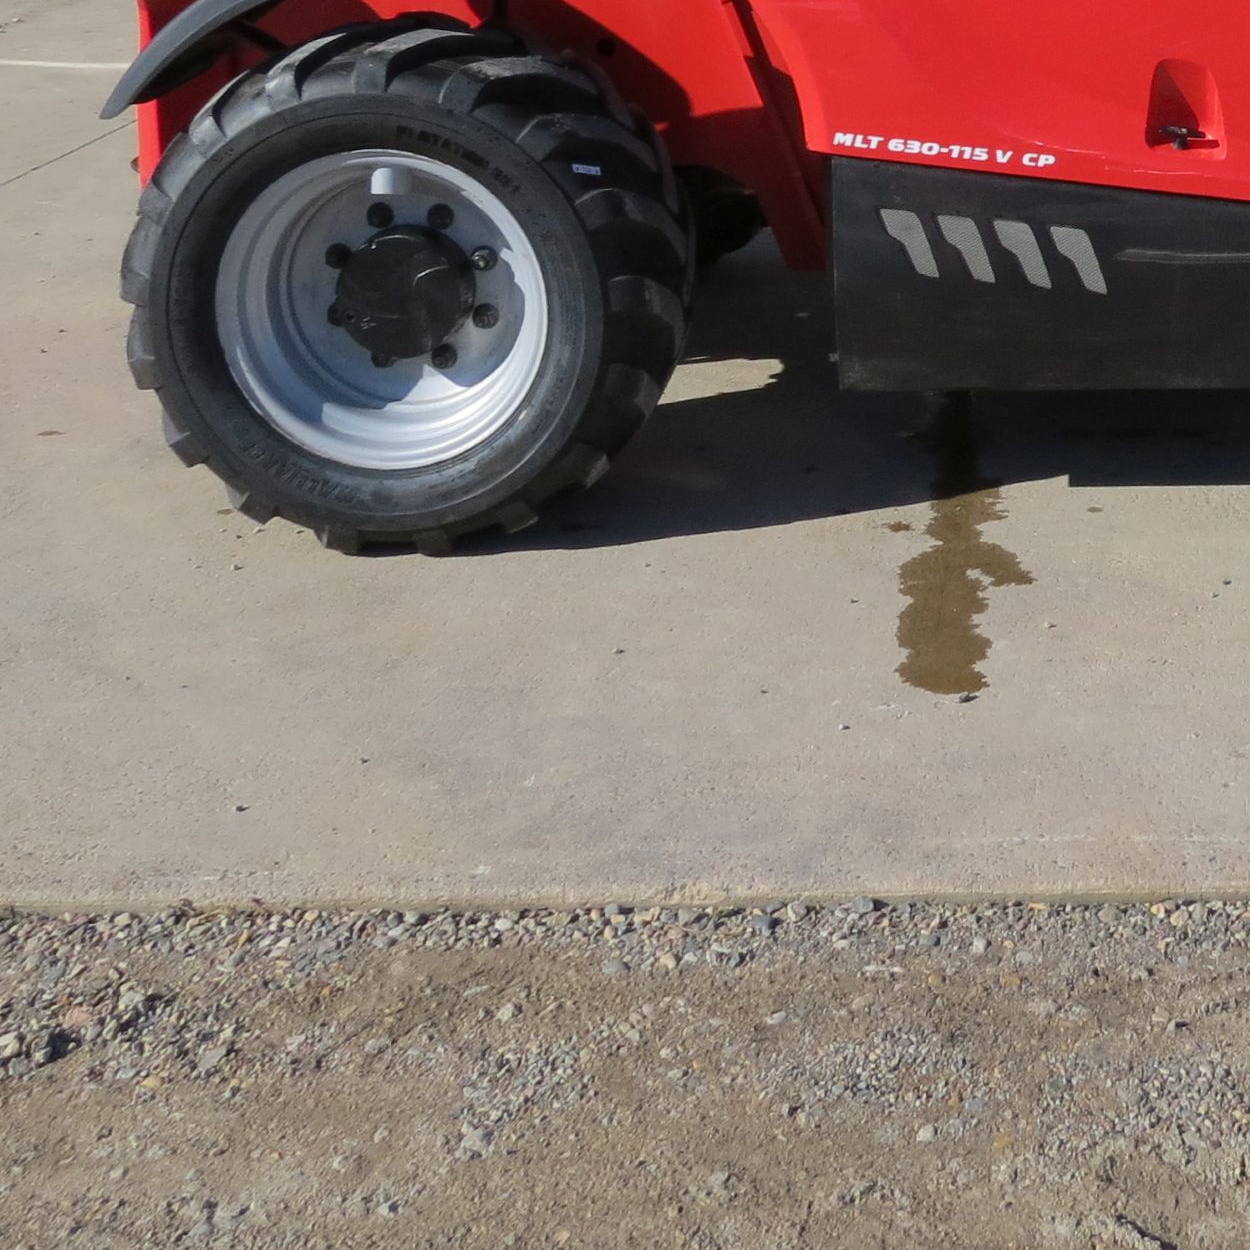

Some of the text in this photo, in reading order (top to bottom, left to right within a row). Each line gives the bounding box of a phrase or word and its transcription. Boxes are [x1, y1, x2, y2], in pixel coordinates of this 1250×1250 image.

[833, 132, 1056, 167] MLT 630-115 V CP
